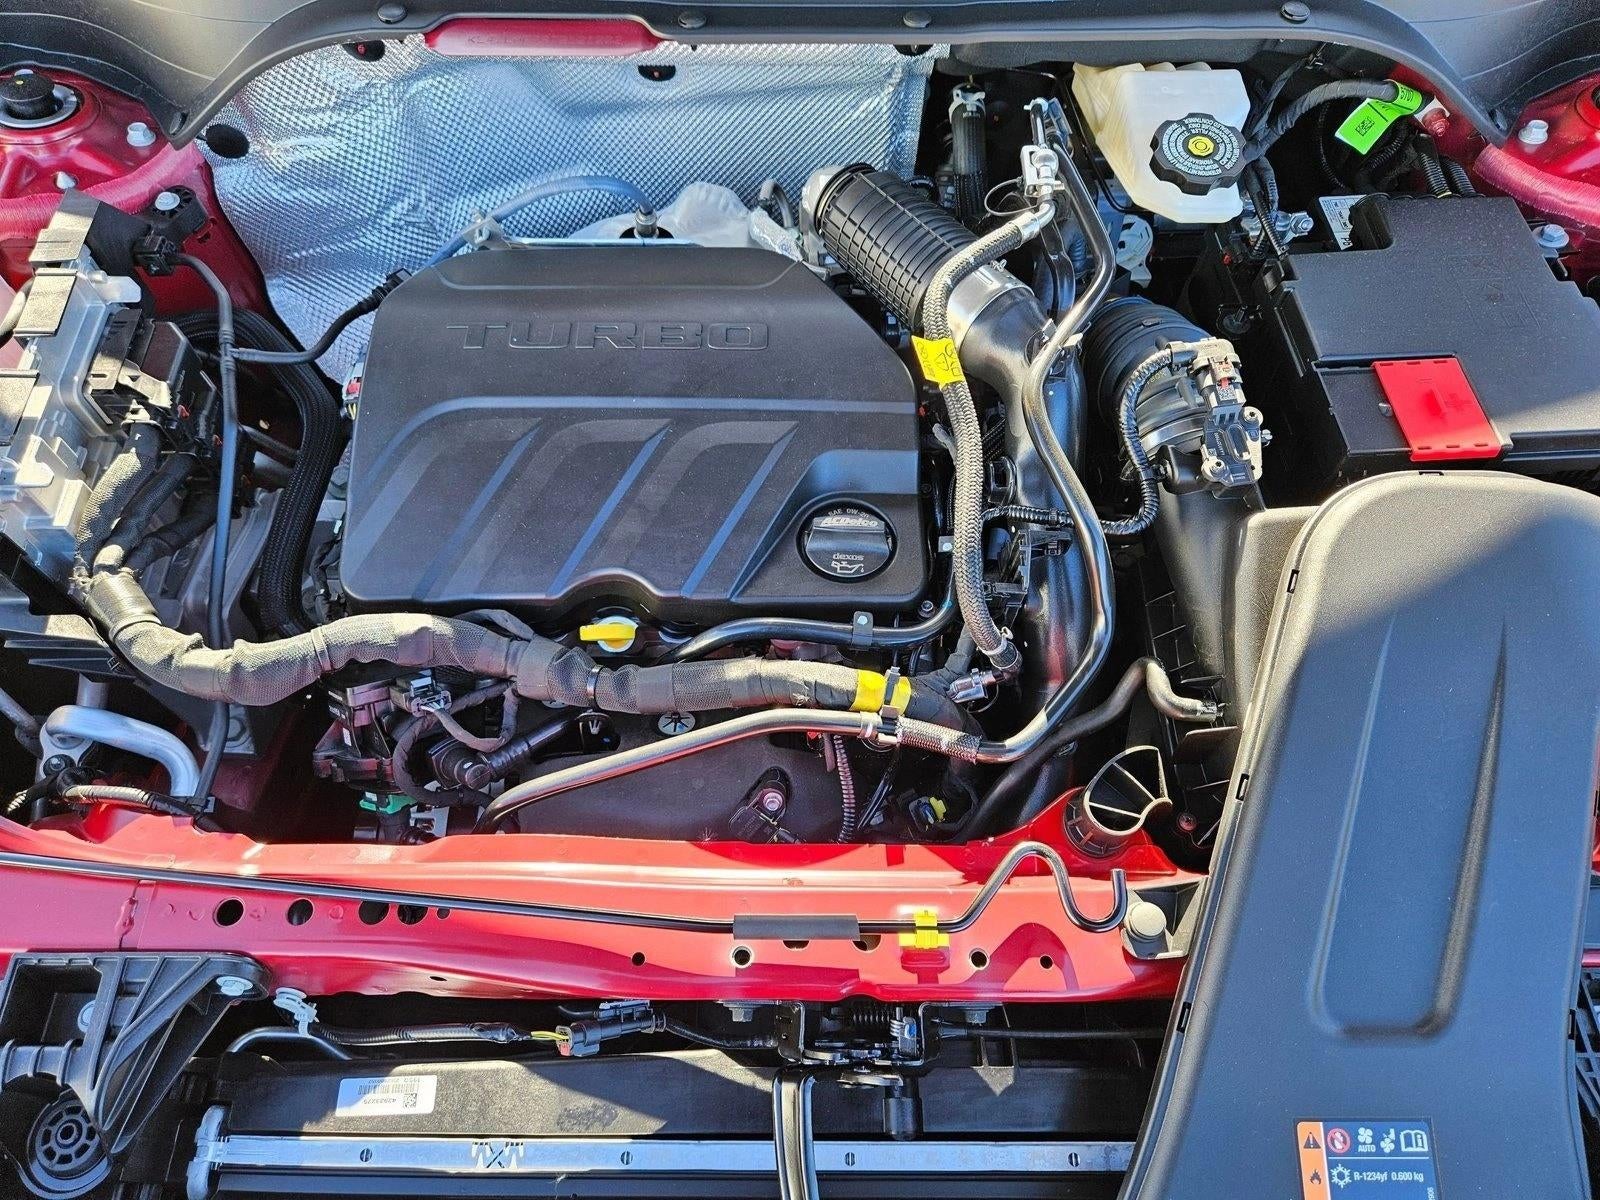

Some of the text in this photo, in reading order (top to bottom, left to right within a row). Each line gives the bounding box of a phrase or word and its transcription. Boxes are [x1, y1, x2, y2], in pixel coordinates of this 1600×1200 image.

[446, 321, 769, 350] TURBO
[828, 508, 842, 516] SAE
[820, 516, 878, 527] ACDelco
[832, 552, 864, 560] dexos
[1358, 1144, 1376, 1152] AUTO
[1354, 1172, 1424, 1182] R-1234yf 0.600 kg
